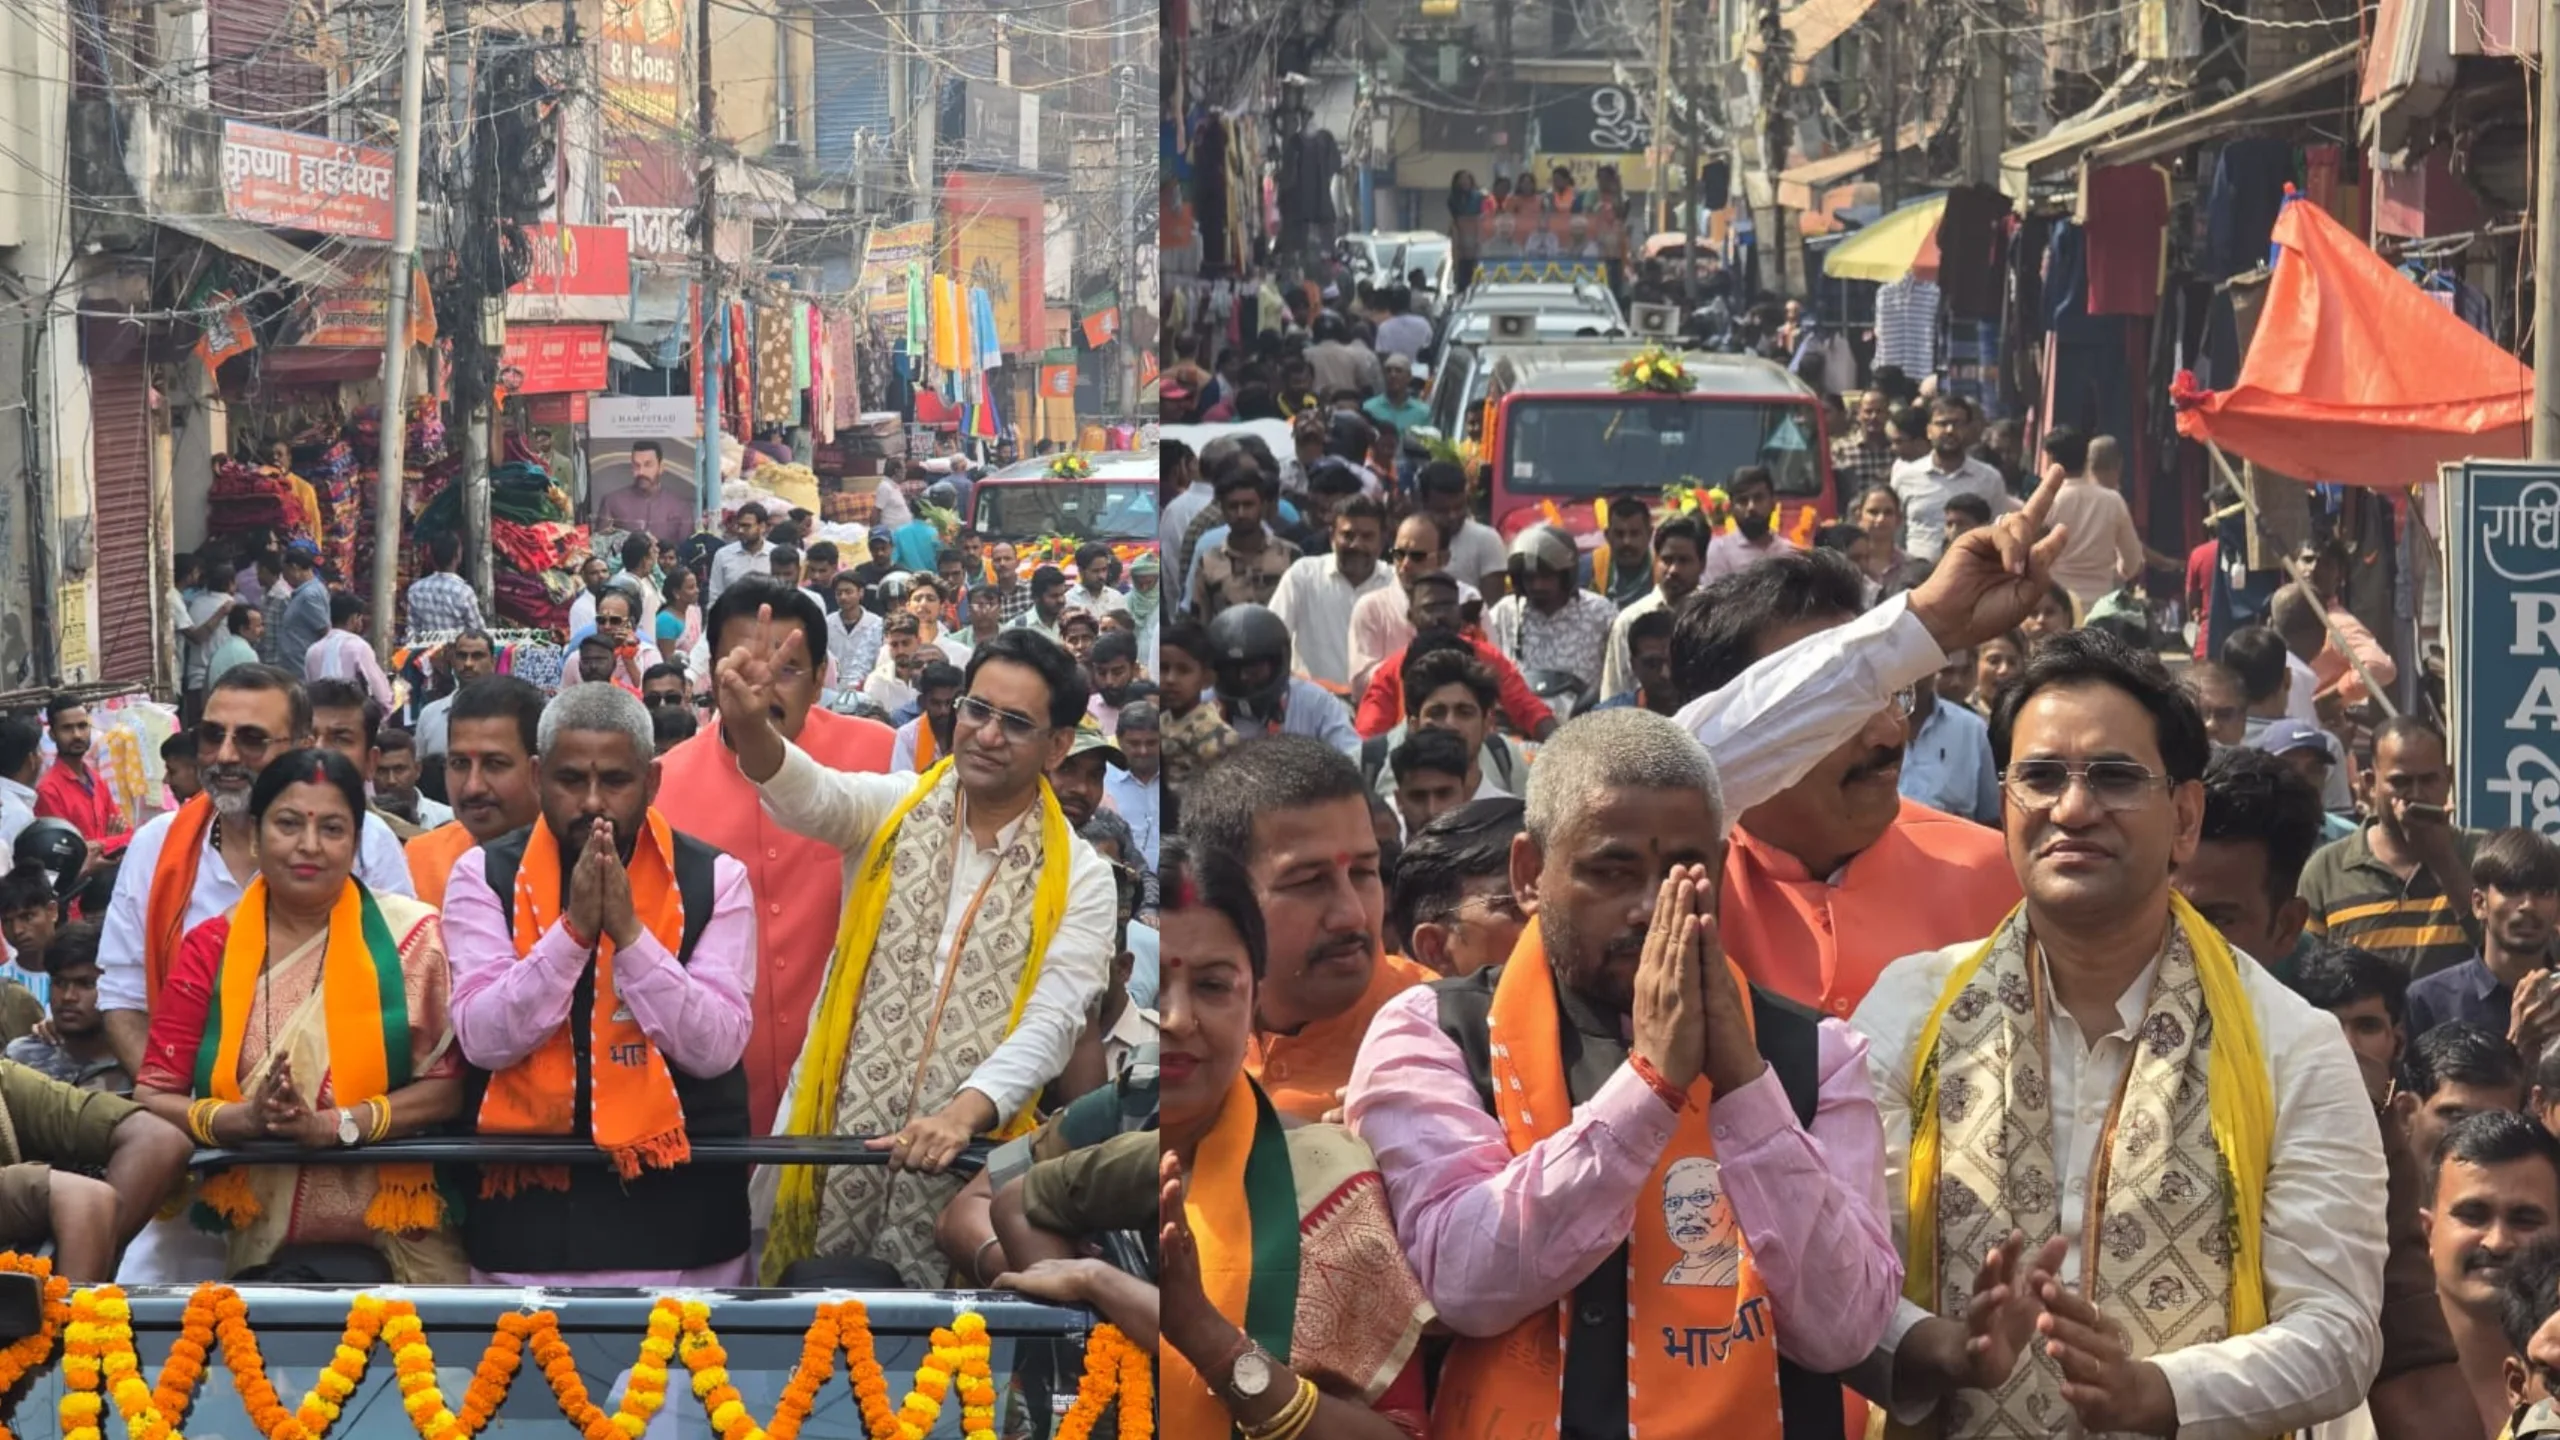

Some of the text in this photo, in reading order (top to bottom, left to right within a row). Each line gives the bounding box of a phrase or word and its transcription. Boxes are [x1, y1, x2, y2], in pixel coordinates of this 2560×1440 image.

[610, 41, 675, 85] & Sons
[223, 141, 292, 194] कृष्णा
